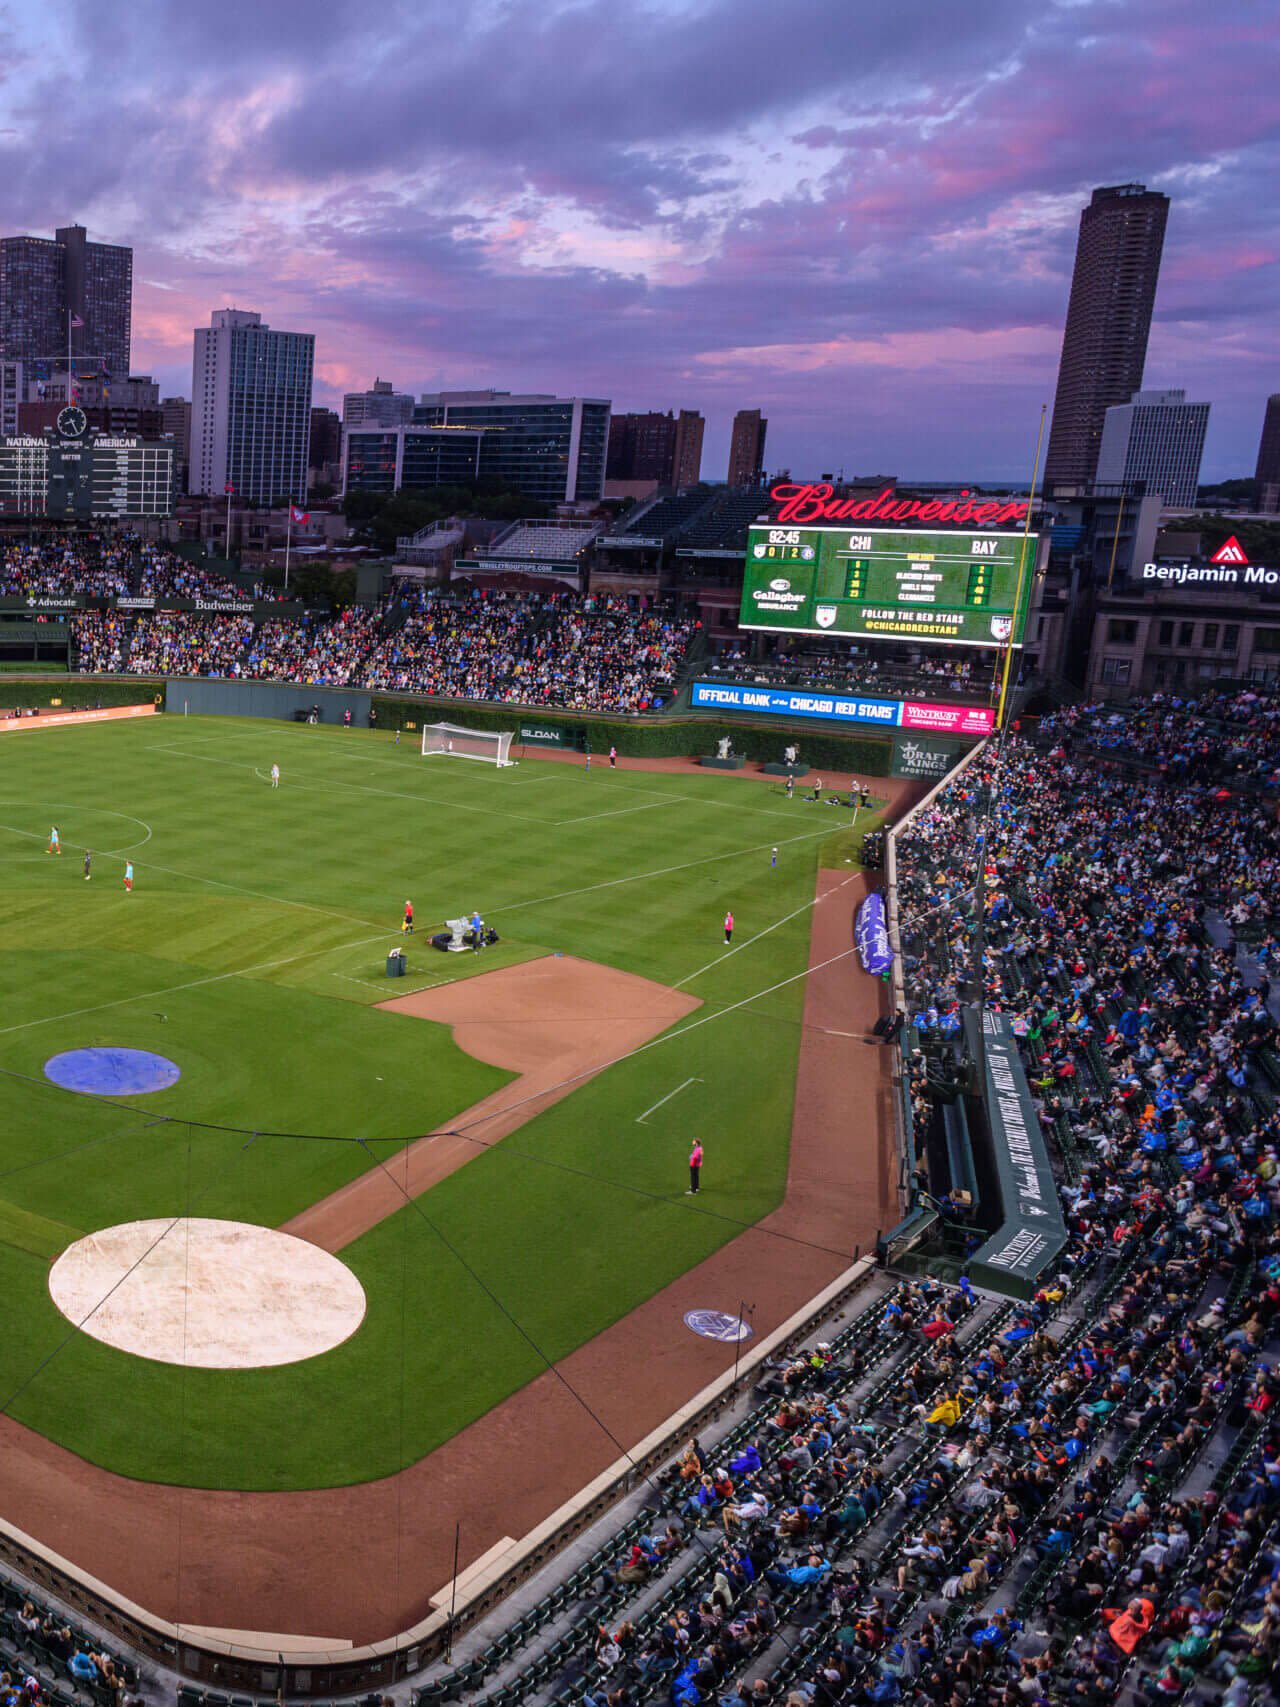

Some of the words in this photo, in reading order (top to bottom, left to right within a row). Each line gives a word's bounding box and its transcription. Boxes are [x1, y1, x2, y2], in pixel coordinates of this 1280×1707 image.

[6, 437, 49, 447] NATIONAL
[93, 437, 137, 448] AMERICAN
[771, 483, 1029, 523] Budweiser
[849, 536, 872, 550] CHI
[971, 540, 998, 555] BAY
[791, 547, 799, 558] 2
[1143, 562, 1238, 584] Benjamin
[1244, 567, 1280, 584] Mo
[38, 598, 76, 606] Advocate
[753, 590, 806, 602] Gallagher
[195, 600, 254, 611] Budweiser
[862, 609, 895, 619] FOLLOW
[897, 611, 914, 620] THE
[916, 612, 934, 622] RED
[936, 614, 964, 624] STARS
[865, 621, 958, 634] @CHICAGOREDSTARS
[699, 689, 741, 704] OFFICIAL
[743, 693, 770, 707] BANK
[789, 697, 833, 713] CHICAGO
[835, 702, 855, 715] RED
[858, 705, 893, 718] STARS
[907, 706, 960, 720] WINTRUST
[521, 729, 560, 740] SLOAN
[902, 751, 950, 762] DRAFT
[907, 759, 946, 770] KINGS
[987, 1228, 1037, 1265] WINTRUST
